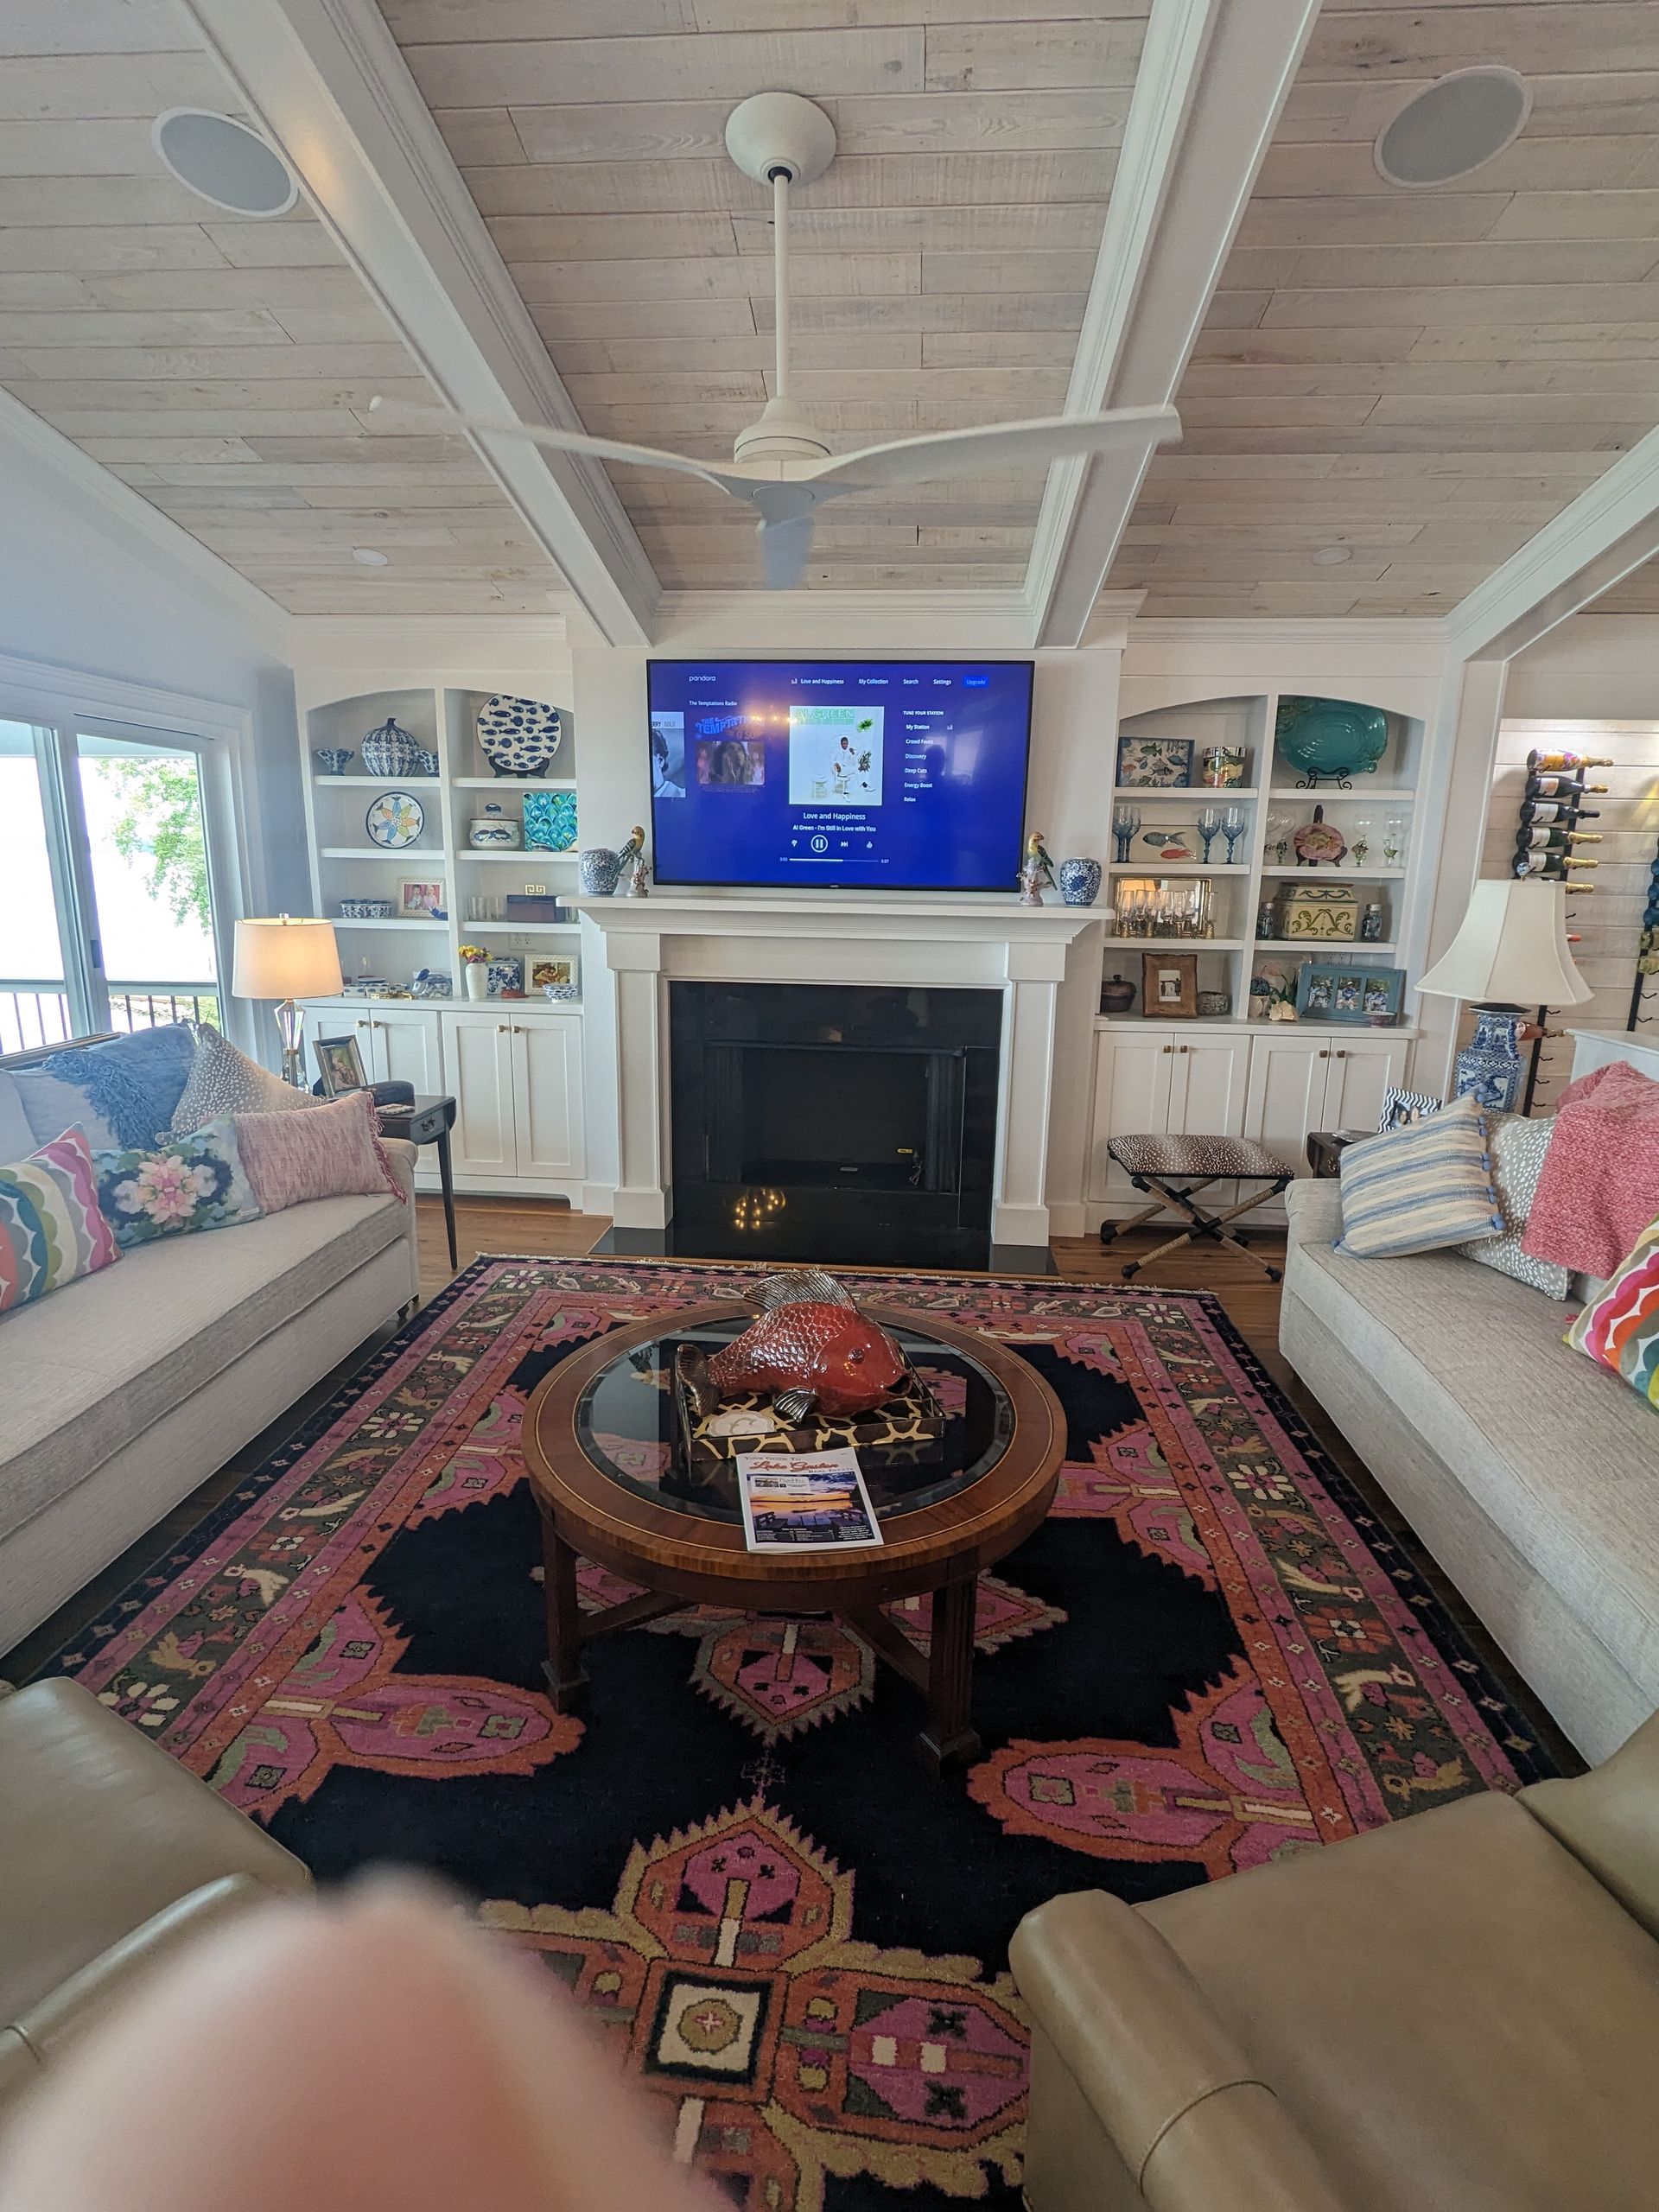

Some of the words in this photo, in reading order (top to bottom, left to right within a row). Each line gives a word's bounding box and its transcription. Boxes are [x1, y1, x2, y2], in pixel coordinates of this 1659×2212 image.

[813, 709, 855, 720] GREEN
[803, 811, 818, 820] Love
[832, 812, 866, 822] Happiness
[749, 1460, 788, 1471] Lake
[789, 1461, 840, 1472] Gaston
